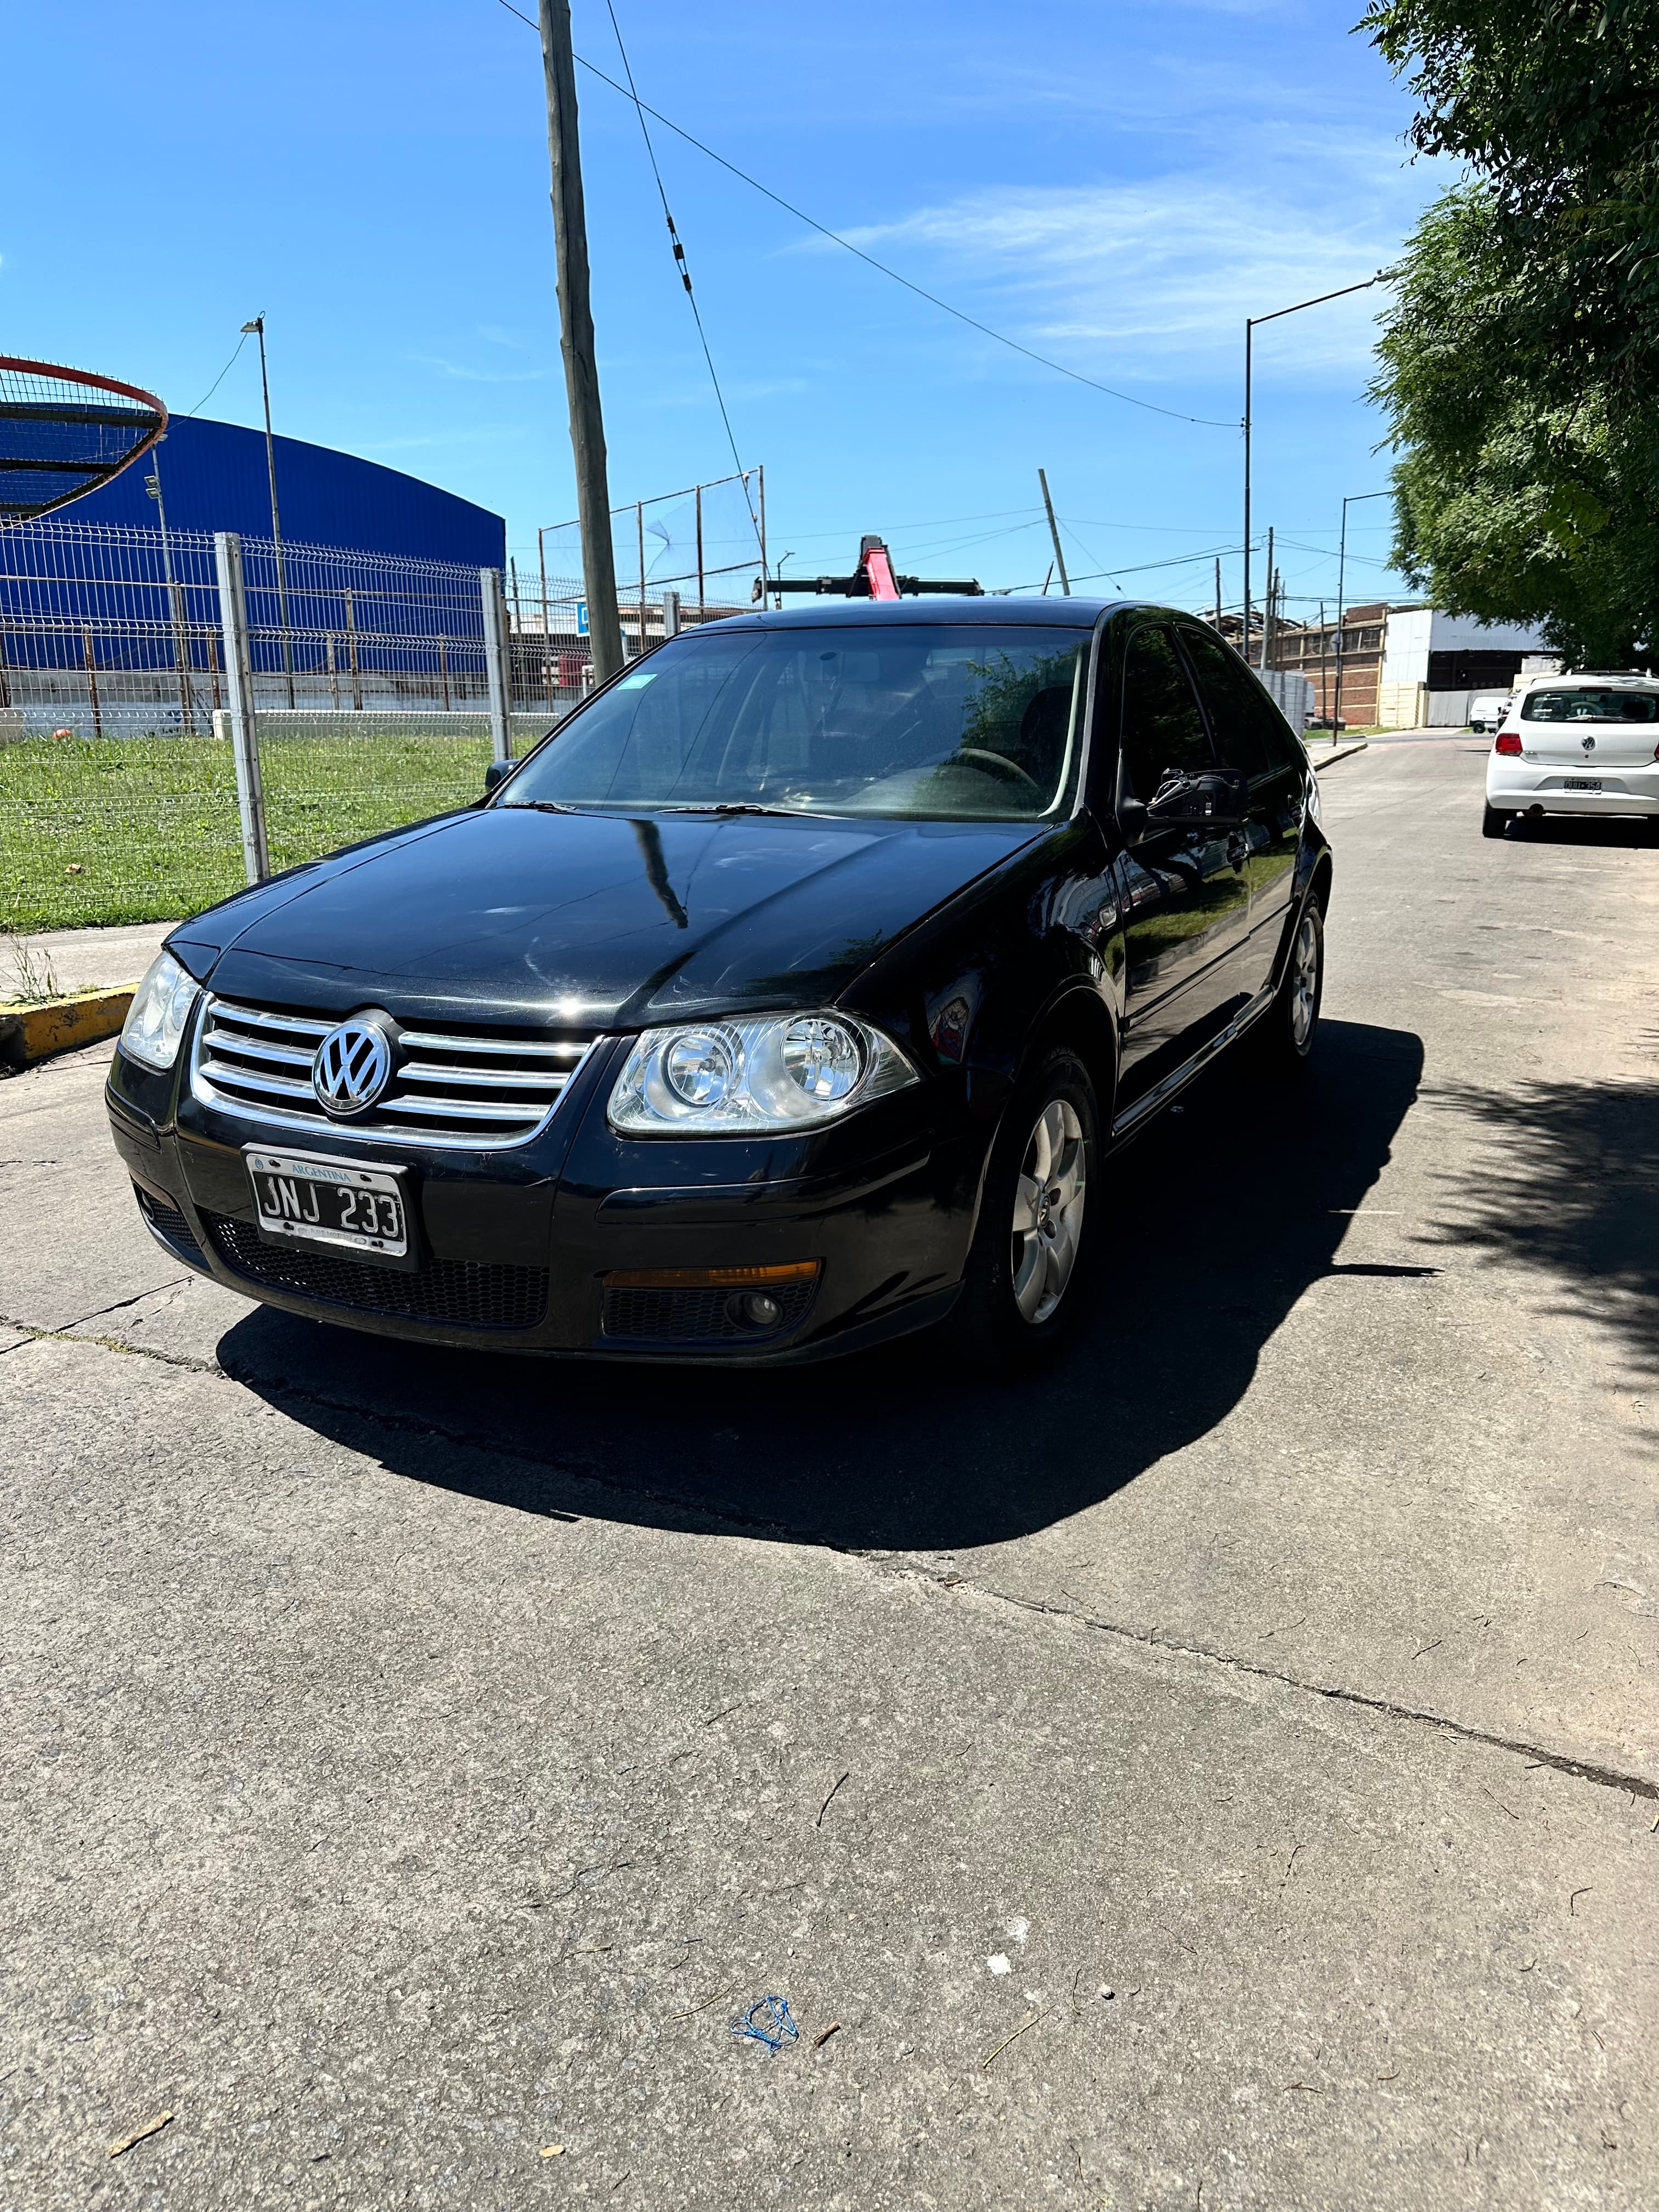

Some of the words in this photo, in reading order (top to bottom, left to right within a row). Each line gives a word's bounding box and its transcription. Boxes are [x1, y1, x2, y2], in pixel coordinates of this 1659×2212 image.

[313, 1020, 390, 1114] VW
[292, 1164, 352, 1182] ARGENTINA
[264, 1176, 320, 1223] JNJ
[337, 1187, 399, 1237] 233
